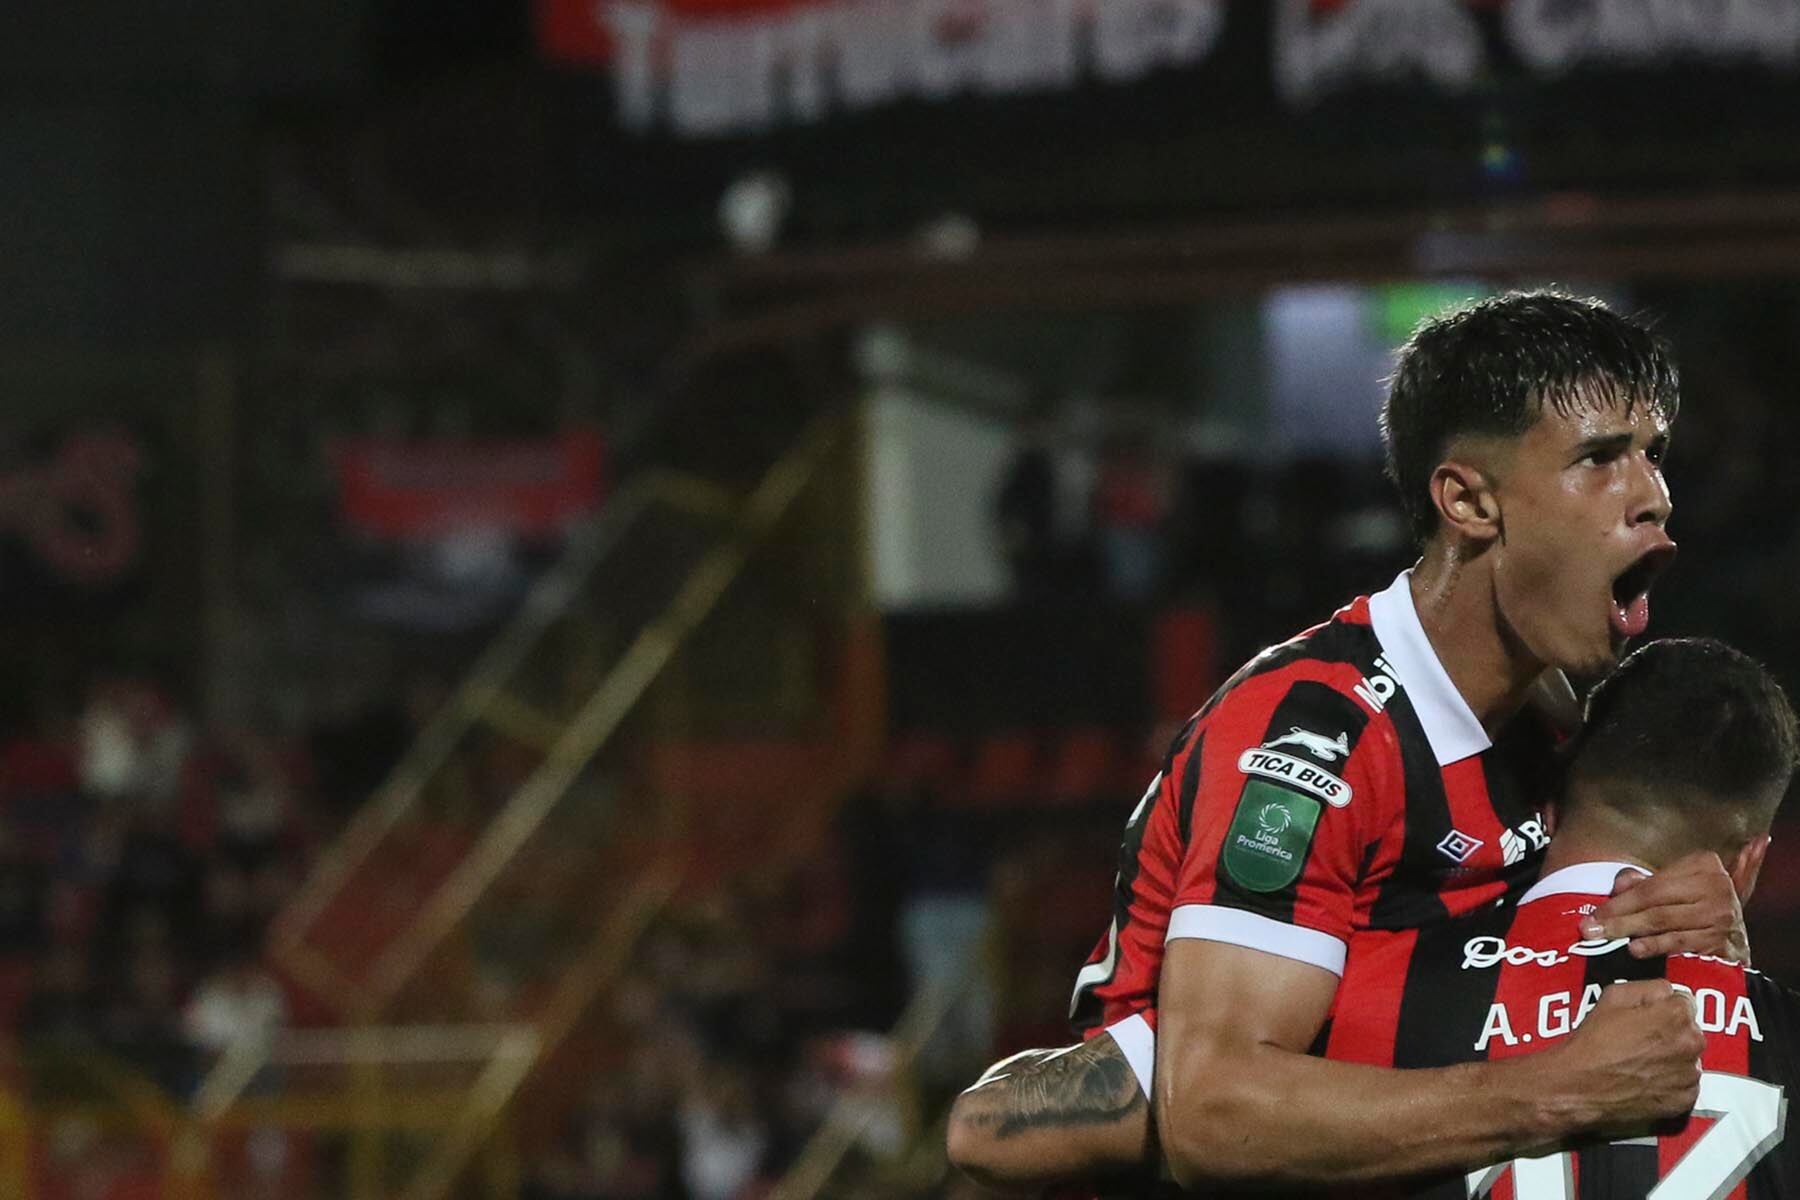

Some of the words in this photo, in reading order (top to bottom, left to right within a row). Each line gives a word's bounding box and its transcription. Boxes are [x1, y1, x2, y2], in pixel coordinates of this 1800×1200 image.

[1248, 754, 1295, 776] TICA
[1296, 768, 1342, 797] BUS
[1255, 830, 1279, 846] Liga
[1461, 936, 1568, 970] Dos
[1474, 978, 1764, 1051] A.GAOA
